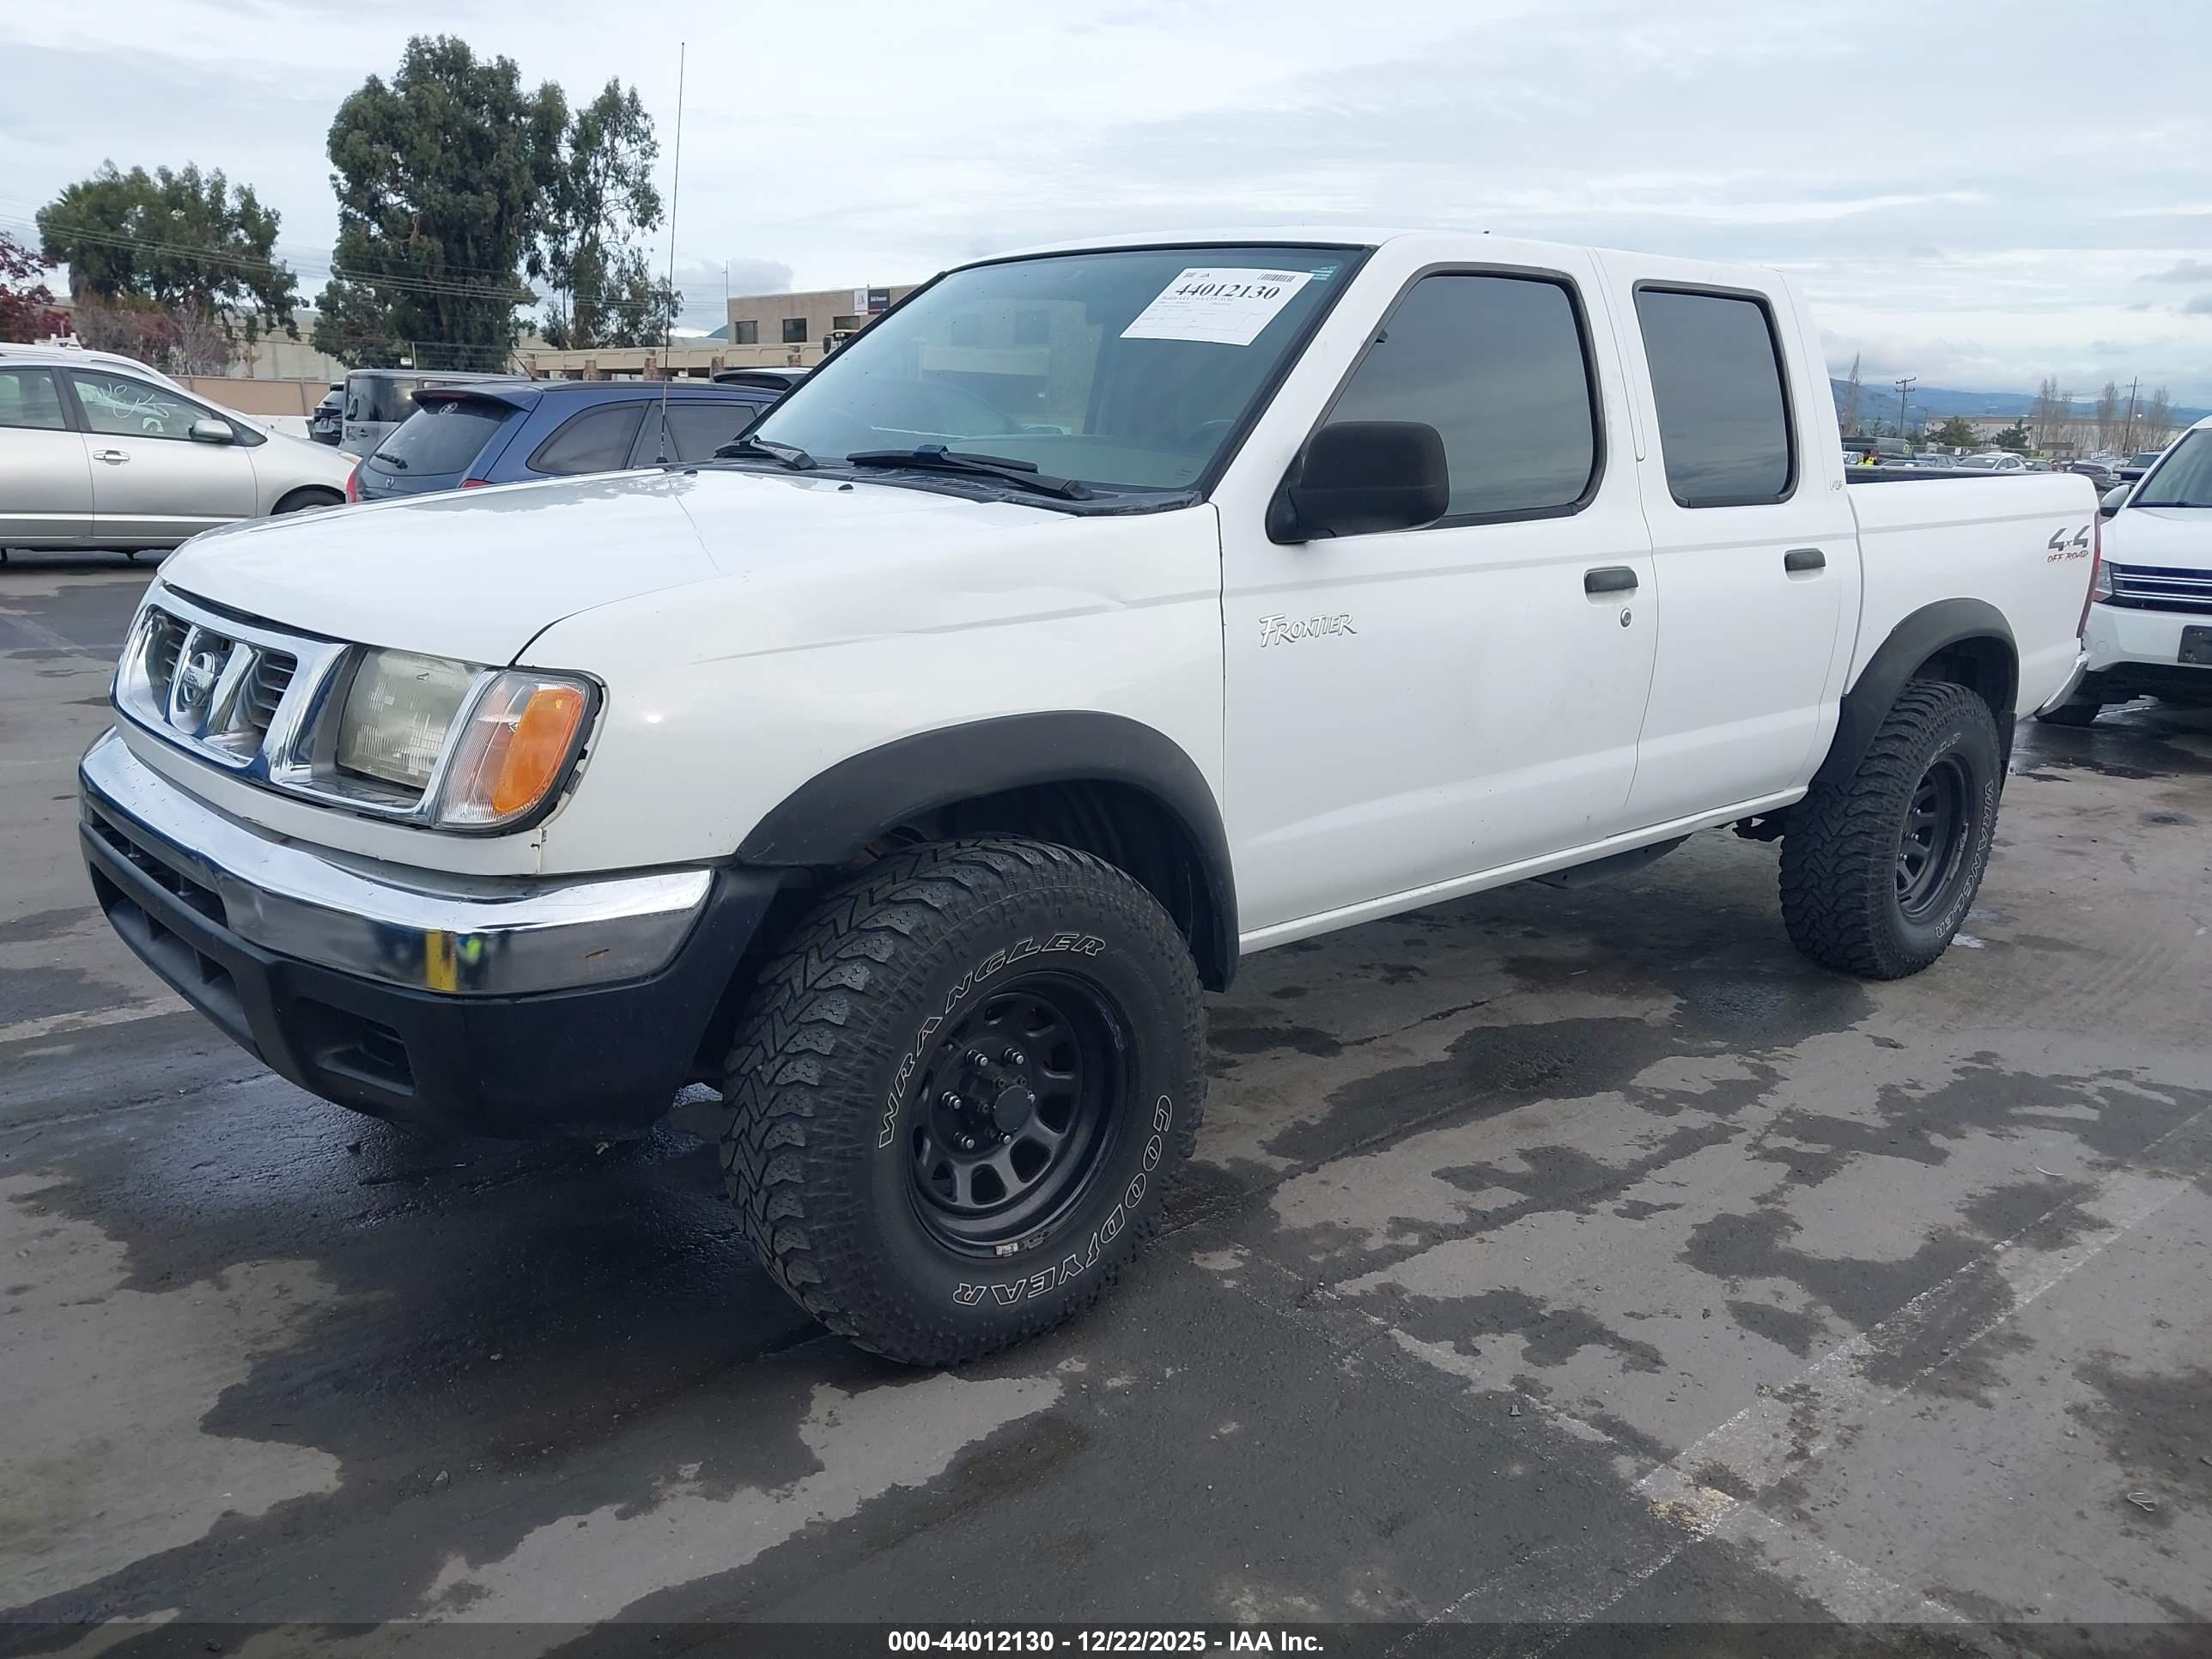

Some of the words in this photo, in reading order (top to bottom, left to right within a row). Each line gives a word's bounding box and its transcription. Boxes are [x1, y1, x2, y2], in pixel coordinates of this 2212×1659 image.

[1175, 283, 1280, 301] 44012130
[2047, 553, 2063, 563] OFF
[2066, 550, 2089, 561] ROAD
[1259, 613, 1358, 647] FRONTIER
[1936, 780, 1994, 939] WRANGLER
[878, 933, 1106, 1149] WRANGLER
[952, 1095, 1173, 1306] GOODYEAR
